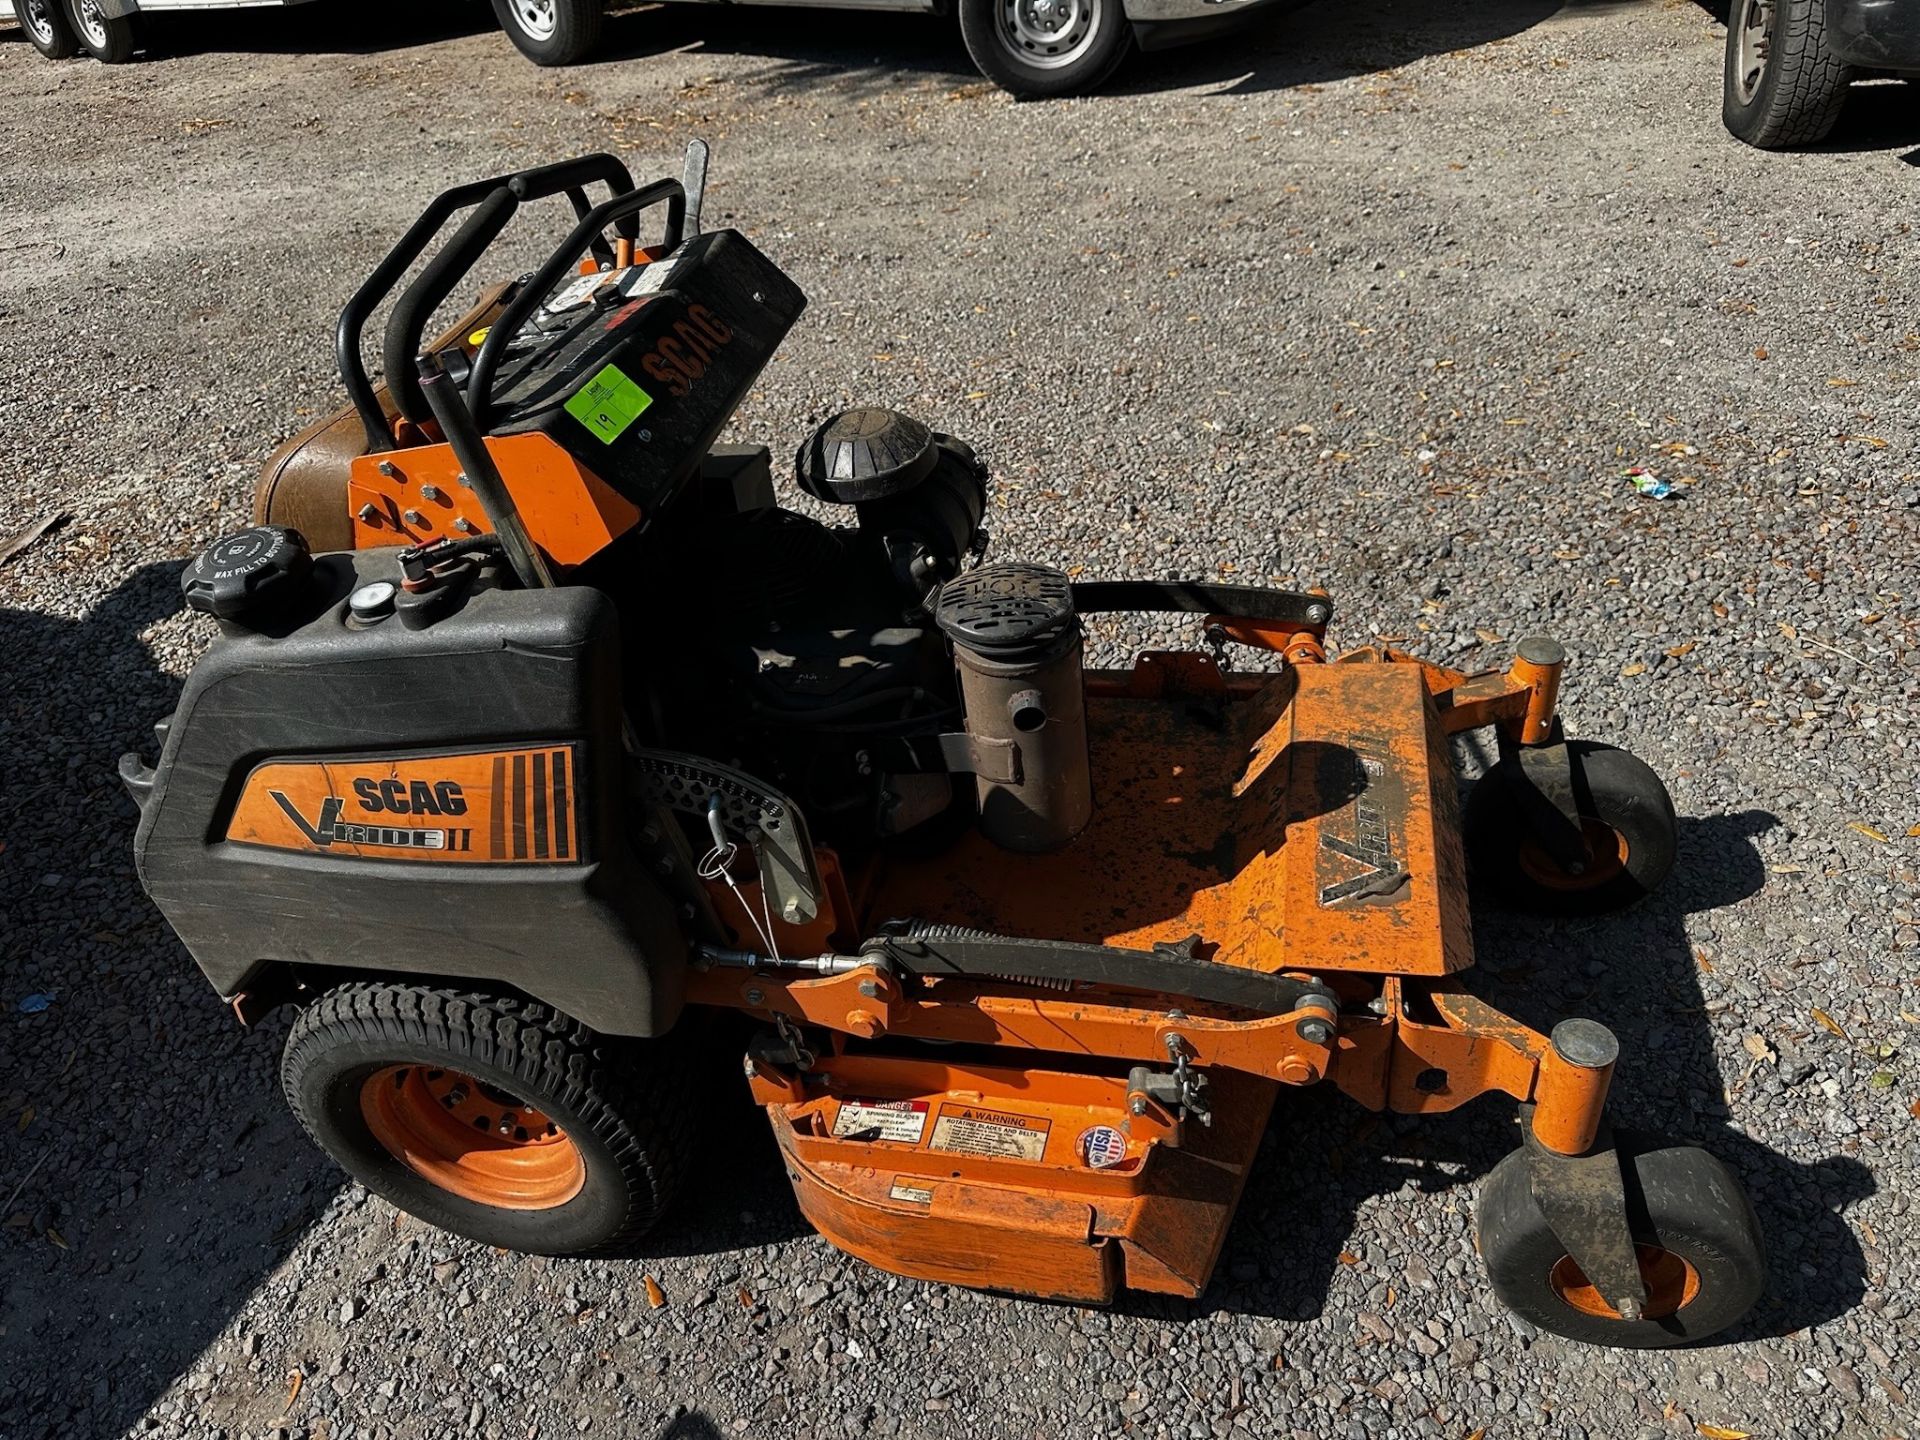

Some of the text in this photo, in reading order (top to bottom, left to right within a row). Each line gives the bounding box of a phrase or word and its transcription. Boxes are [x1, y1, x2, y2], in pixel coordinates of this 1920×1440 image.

[641, 303, 734, 398] SCAG
[595, 413, 617, 432] 19
[214, 569, 233, 579] MAX
[234, 564, 255, 576] FILL
[253, 557, 268, 567] TO
[352, 777, 469, 816] SCAG
[946, 1118, 977, 1128] ROTATING
[977, 1123, 1002, 1132] BLADES
[1018, 1130, 1038, 1138] BELTS
[975, 1111, 1026, 1127] WARNING
[1092, 1129, 1112, 1152] USA
